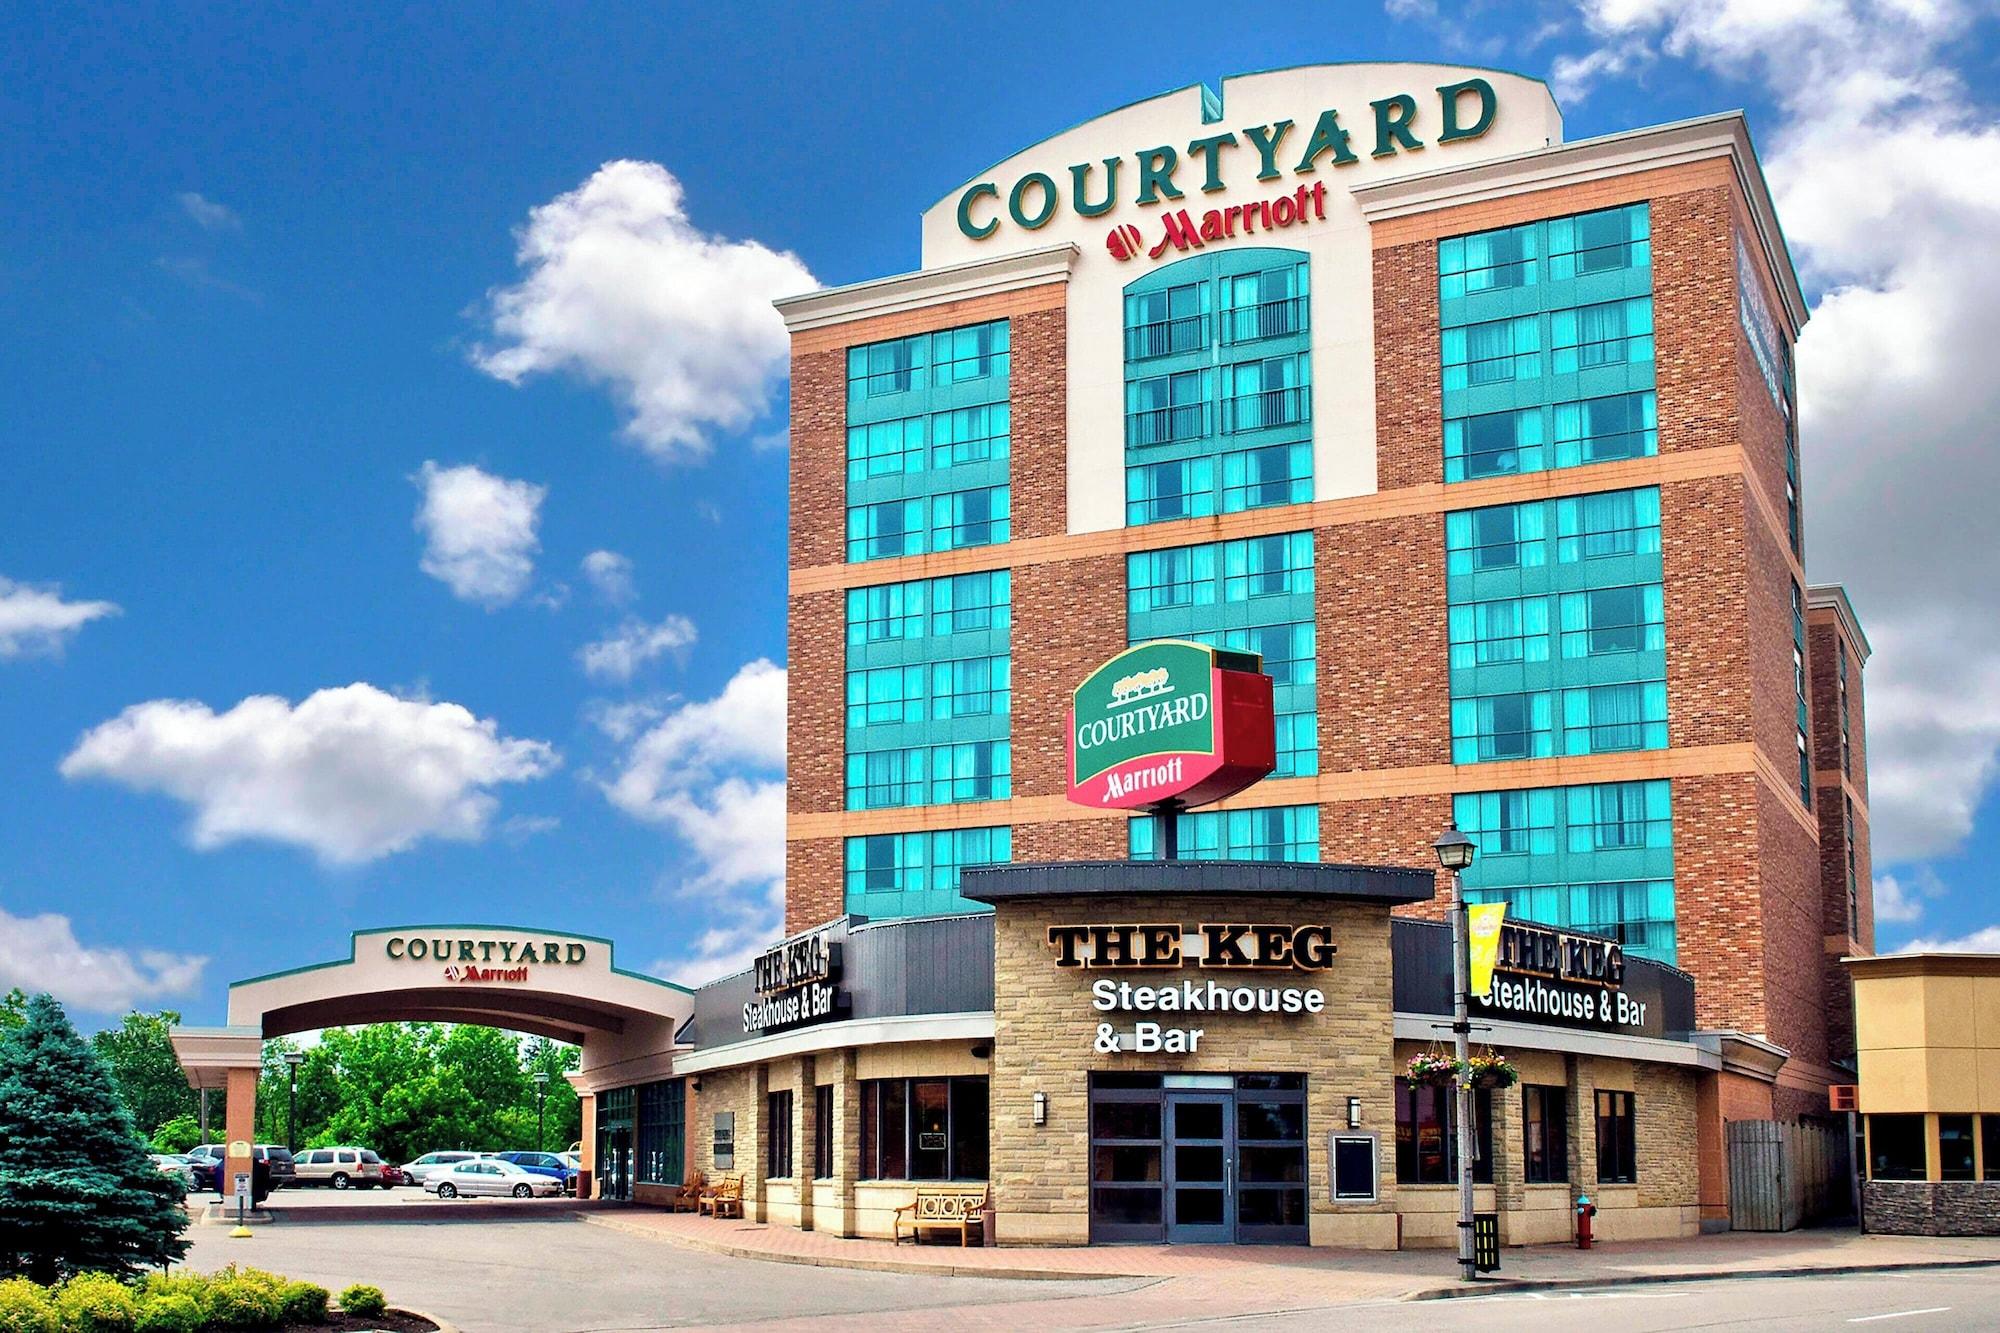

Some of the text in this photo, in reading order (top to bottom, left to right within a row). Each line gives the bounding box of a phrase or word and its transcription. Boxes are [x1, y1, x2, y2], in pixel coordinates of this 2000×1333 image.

[956, 78, 1498, 240] COURTYARD
[1148, 180, 1327, 258] Marriott
[1078, 693, 1208, 750] COURTYARD
[1102, 757, 1182, 802] Marriott
[386, 938, 586, 964] COURTYARD
[754, 931, 829, 995] THE KEG
[1047, 924, 1337, 971] THE KEG
[1495, 924, 1626, 989] THE KEG
[460, 965, 528, 982] Marriott
[1092, 979, 1325, 1013] Steakhouse
[743, 983, 832, 1032] Steakhouse & Bar
[1600, 989, 1612, 1022] &
[1617, 992, 1647, 1026] Bar
[1093, 1022, 1204, 1053] & Bar
